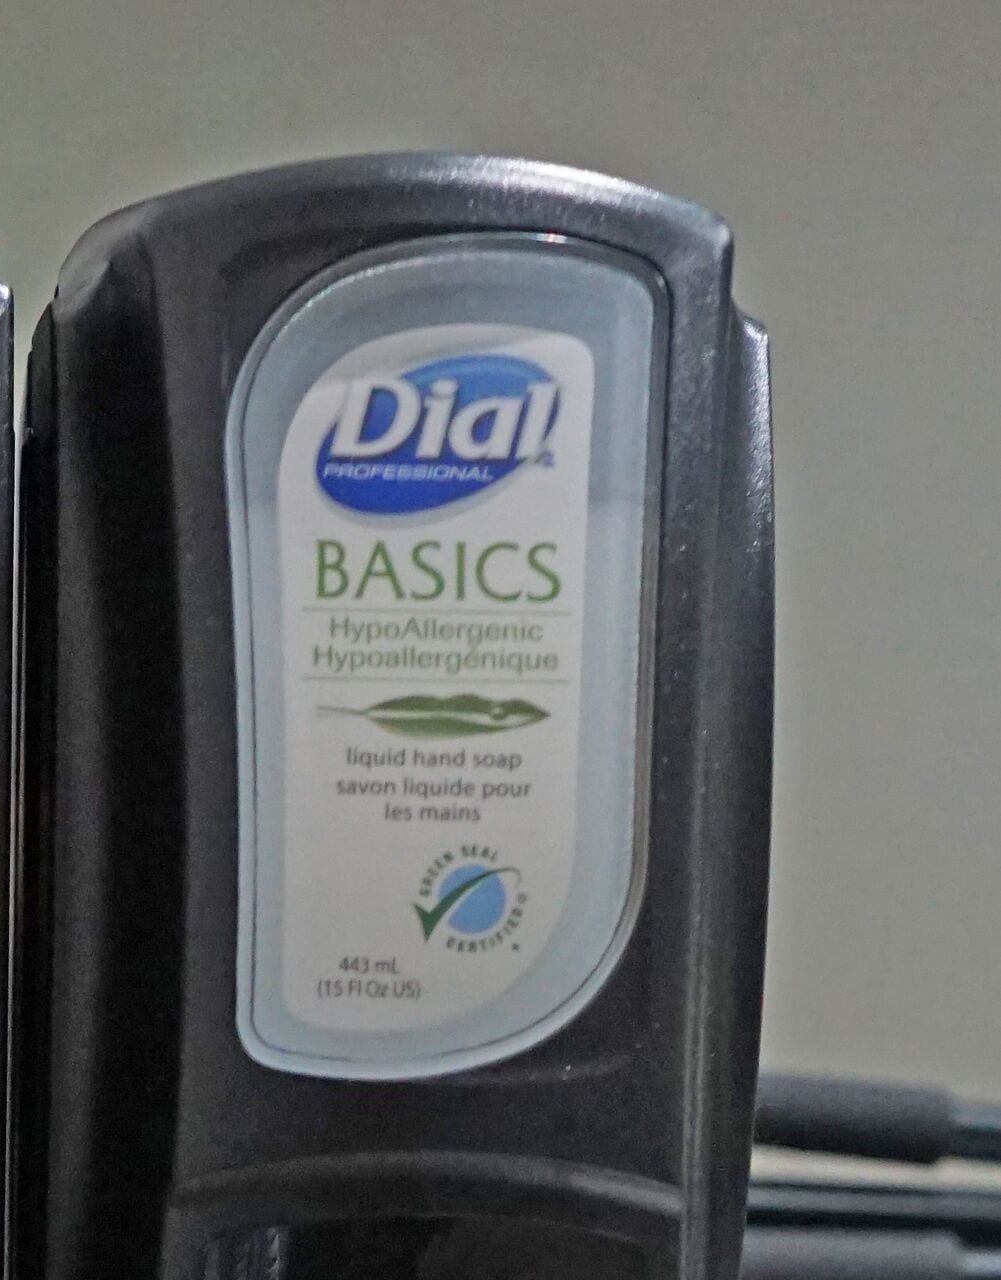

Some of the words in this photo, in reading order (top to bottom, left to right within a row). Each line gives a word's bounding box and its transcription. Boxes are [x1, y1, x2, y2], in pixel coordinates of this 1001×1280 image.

[331, 377, 560, 461] Dial
[323, 463, 494, 482] PROFESSIONAL
[315, 539, 561, 603] BASICS
[328, 616, 544, 645] HypoAllergenic
[313, 645, 559, 675] Hypoallergénique
[346, 747, 406, 769] liquid
[412, 748, 465, 768] hand
[472, 750, 522, 771] soap
[336, 778, 396, 796] savon
[402, 777, 475, 799] liquide
[481, 782, 532, 799] pour
[384, 802, 412, 822] les
[419, 804, 481, 822] mains
[419, 851, 454, 898] GREEN
[446, 893, 528, 953] CERTIFIED
[338, 956, 370, 973] 443
[374, 956, 400, 973] mL
[316, 979, 345, 1000] (15
[366, 980, 389, 998] Oz
[392, 980, 422, 999] US)
